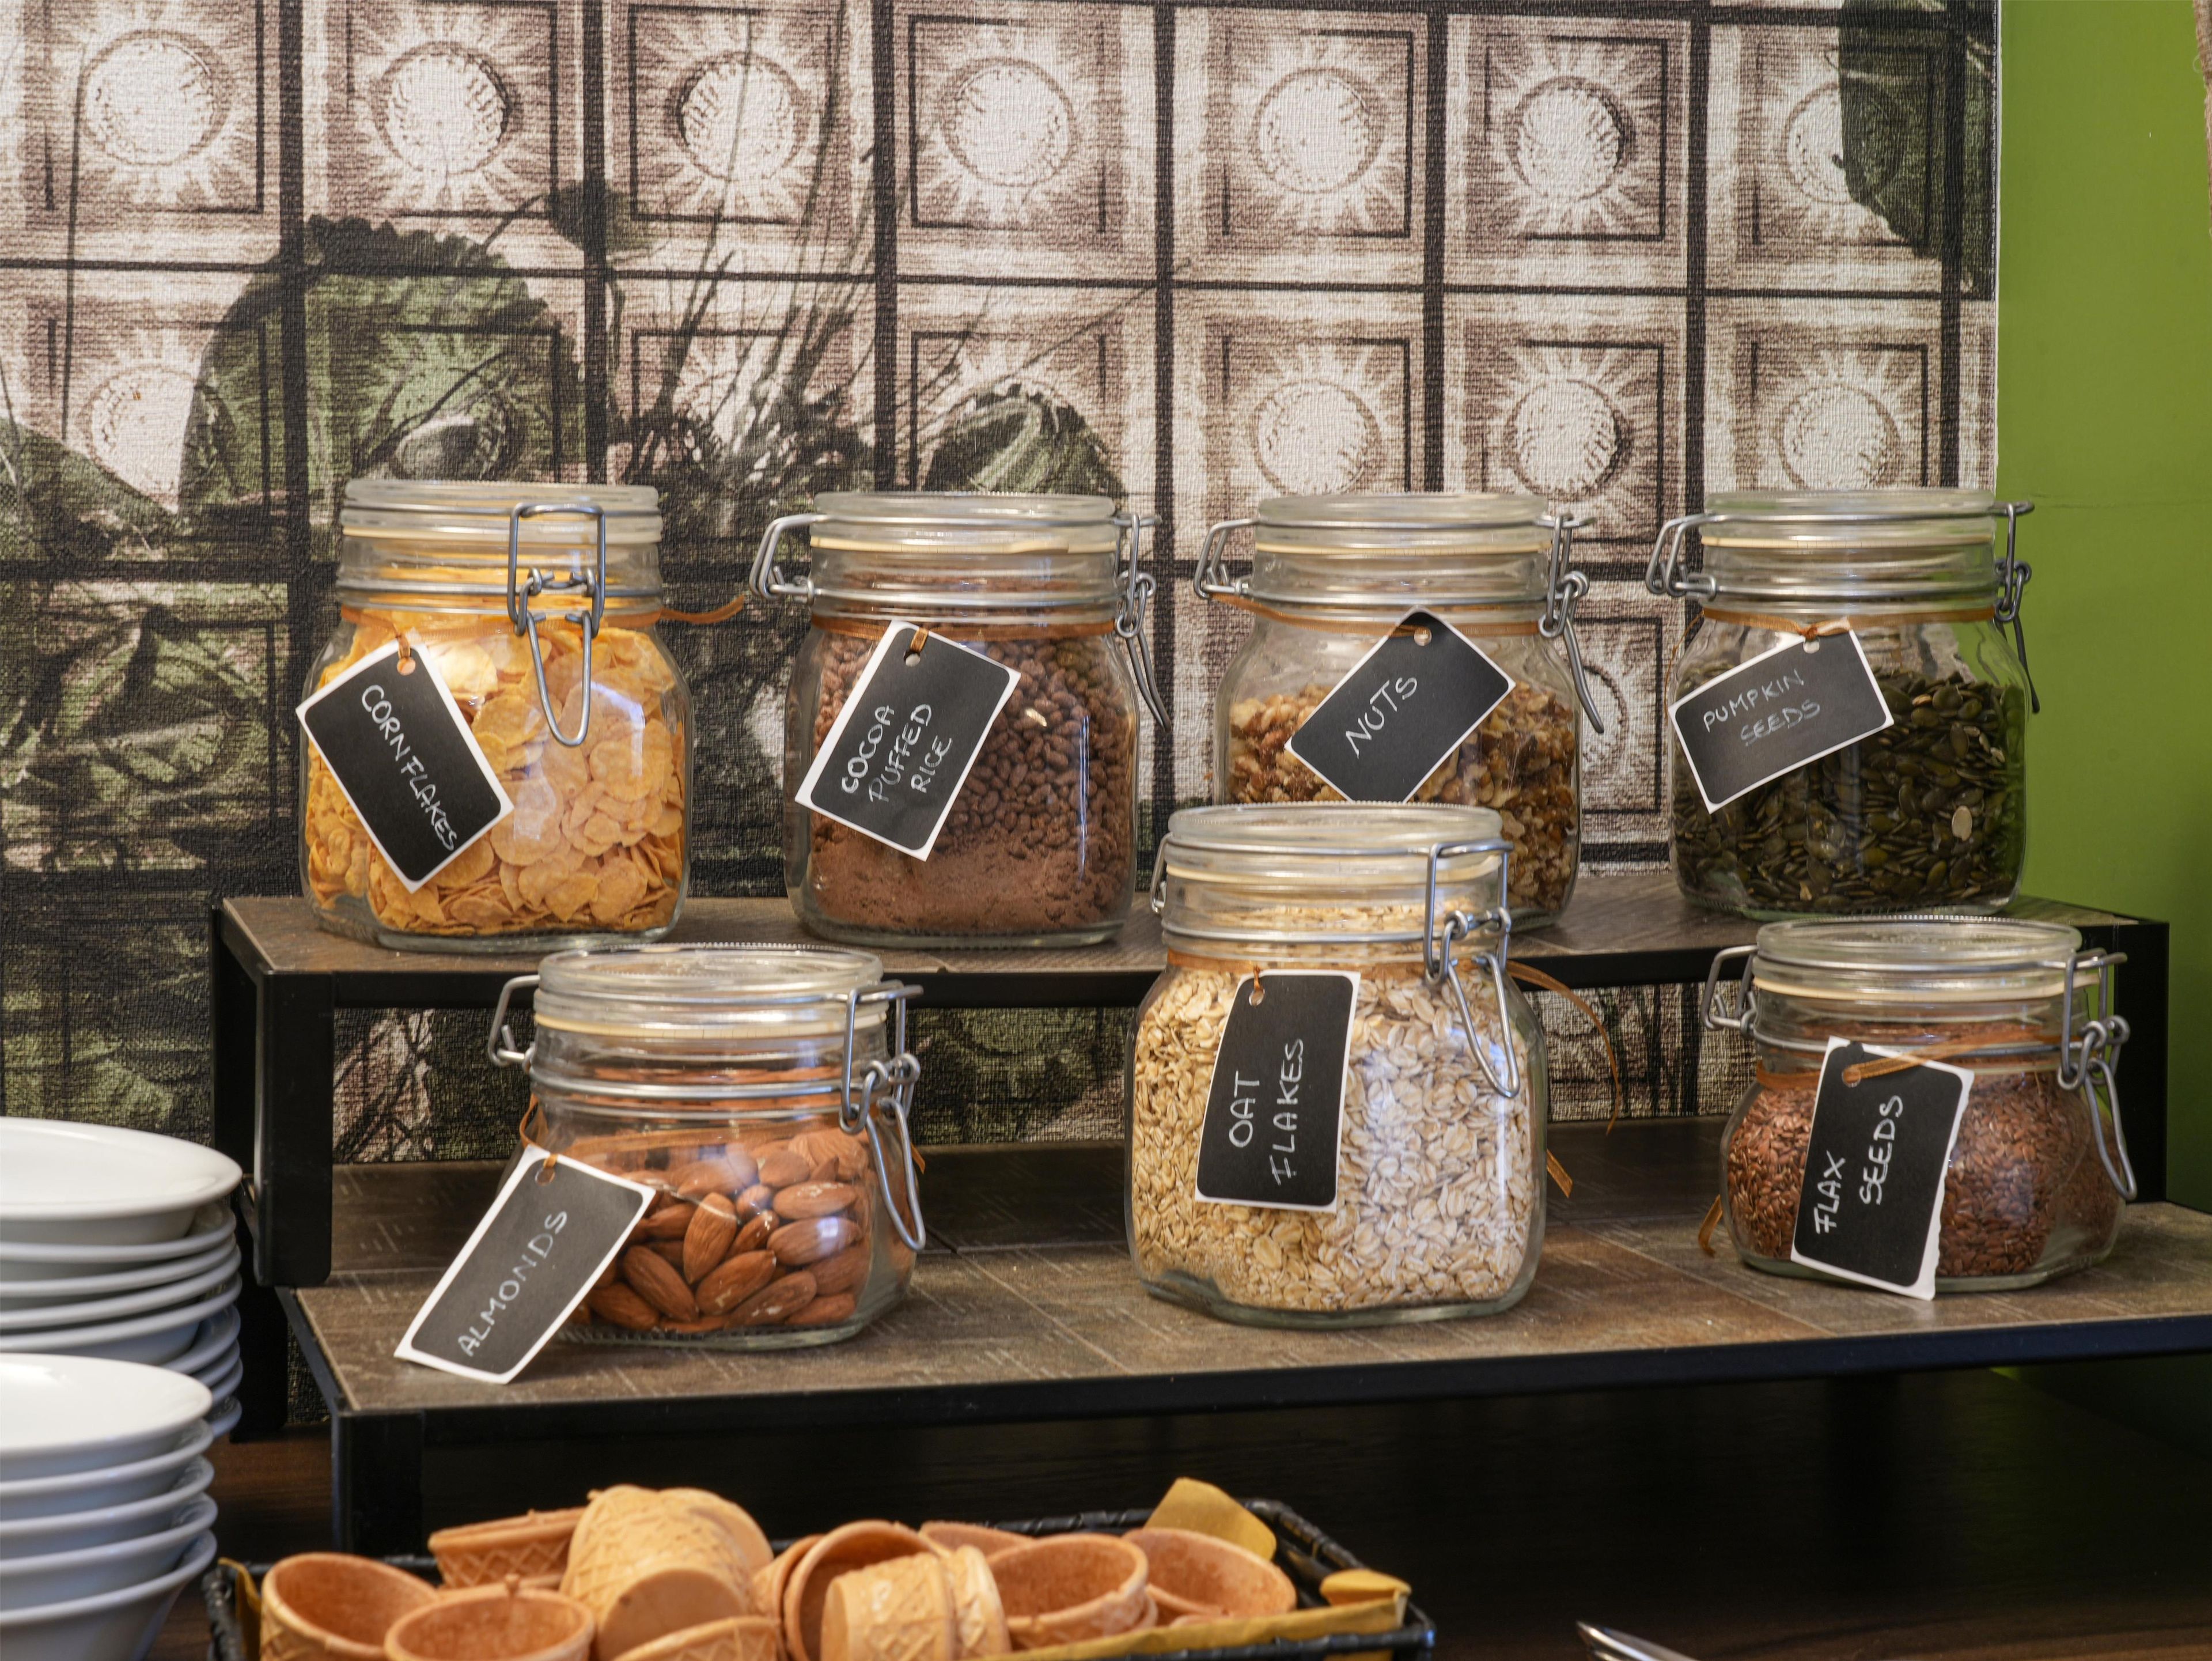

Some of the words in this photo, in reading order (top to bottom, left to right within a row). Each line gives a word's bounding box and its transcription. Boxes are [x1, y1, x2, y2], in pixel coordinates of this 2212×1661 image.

[1345, 676, 1418, 759] NUTS
[1702, 668, 1805, 733] PUMPKIN
[1740, 699, 1821, 747] SEEDS
[841, 705, 895, 794] COCOA
[868, 703, 933, 803] PUFFED
[910, 735, 953, 793] RICE
[1228, 1070, 1260, 1148] OAT
[1269, 1038, 1304, 1186] FLAKES
[1859, 1095, 1903, 1205] SEEDS
[1813, 1150, 1846, 1235] FLAX
[457, 1210, 568, 1357] ALMONDS
